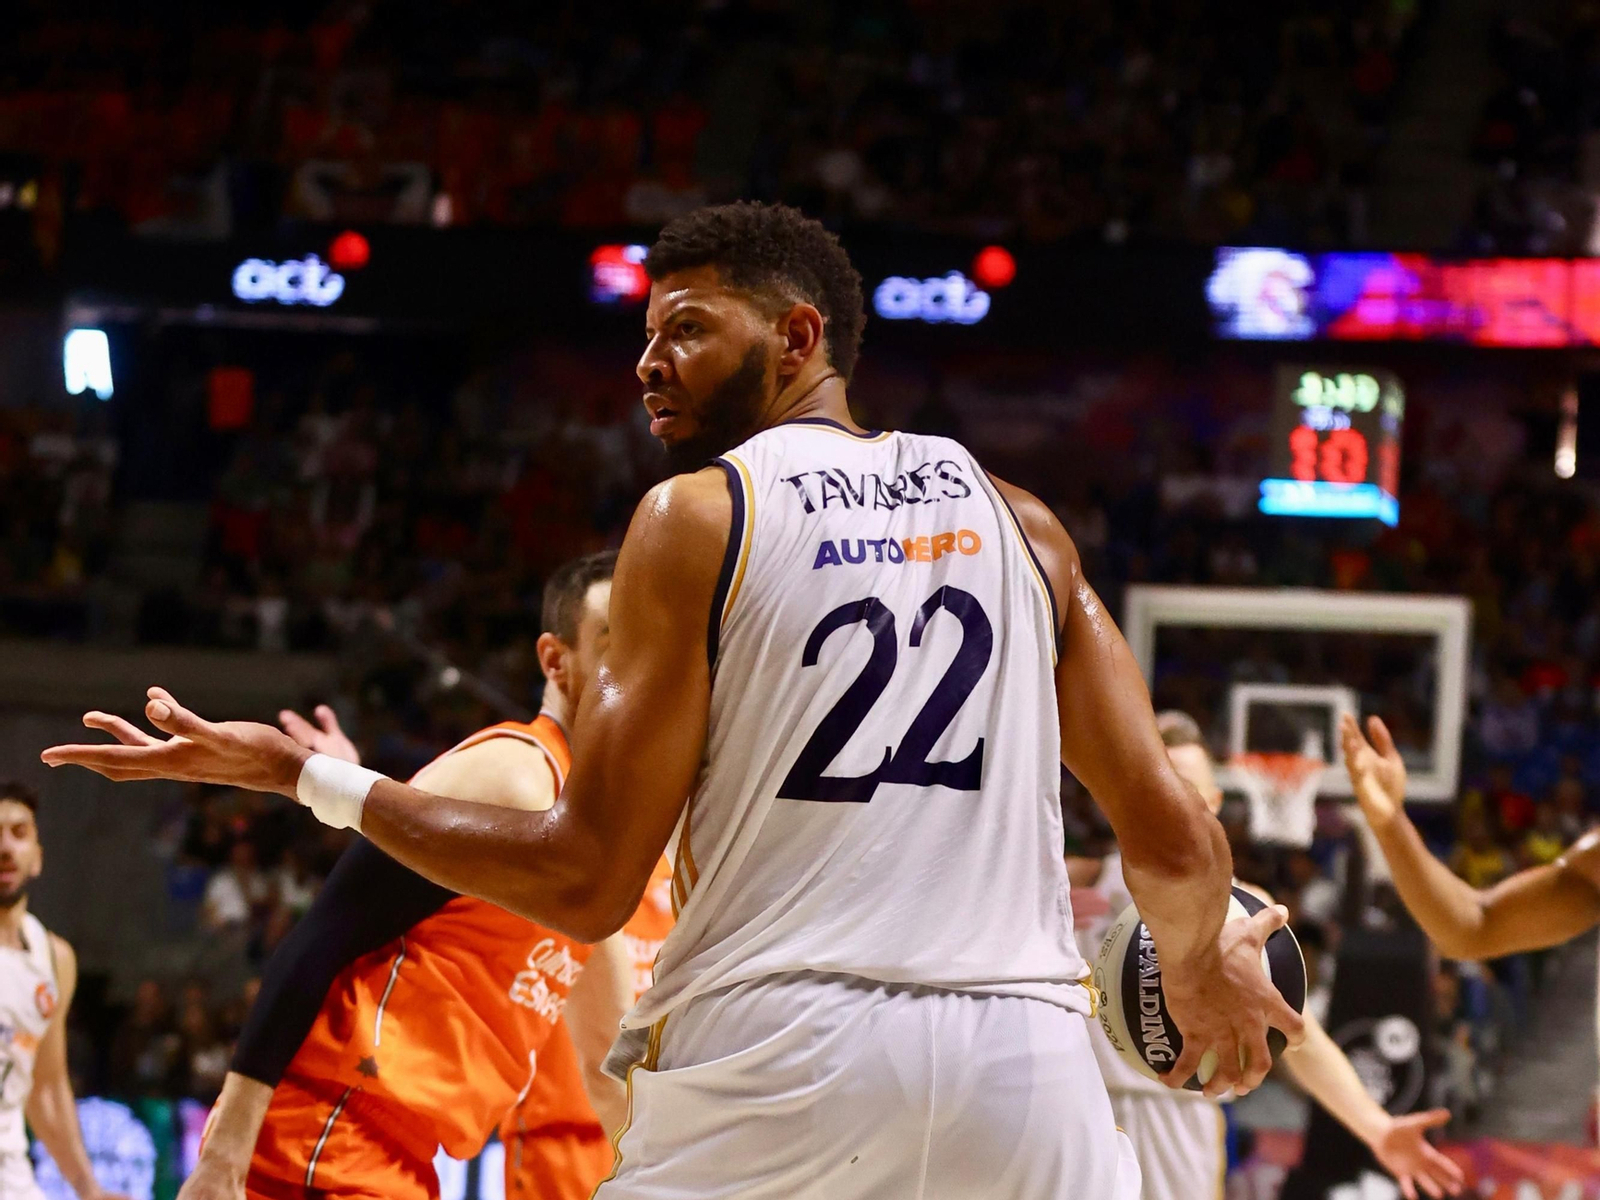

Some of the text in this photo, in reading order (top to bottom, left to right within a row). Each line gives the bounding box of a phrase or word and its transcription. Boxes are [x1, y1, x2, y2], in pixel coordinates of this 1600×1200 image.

[780, 460, 971, 514] TAVARES
[812, 529, 982, 570] AUTOHERO
[775, 585, 993, 803] 22
